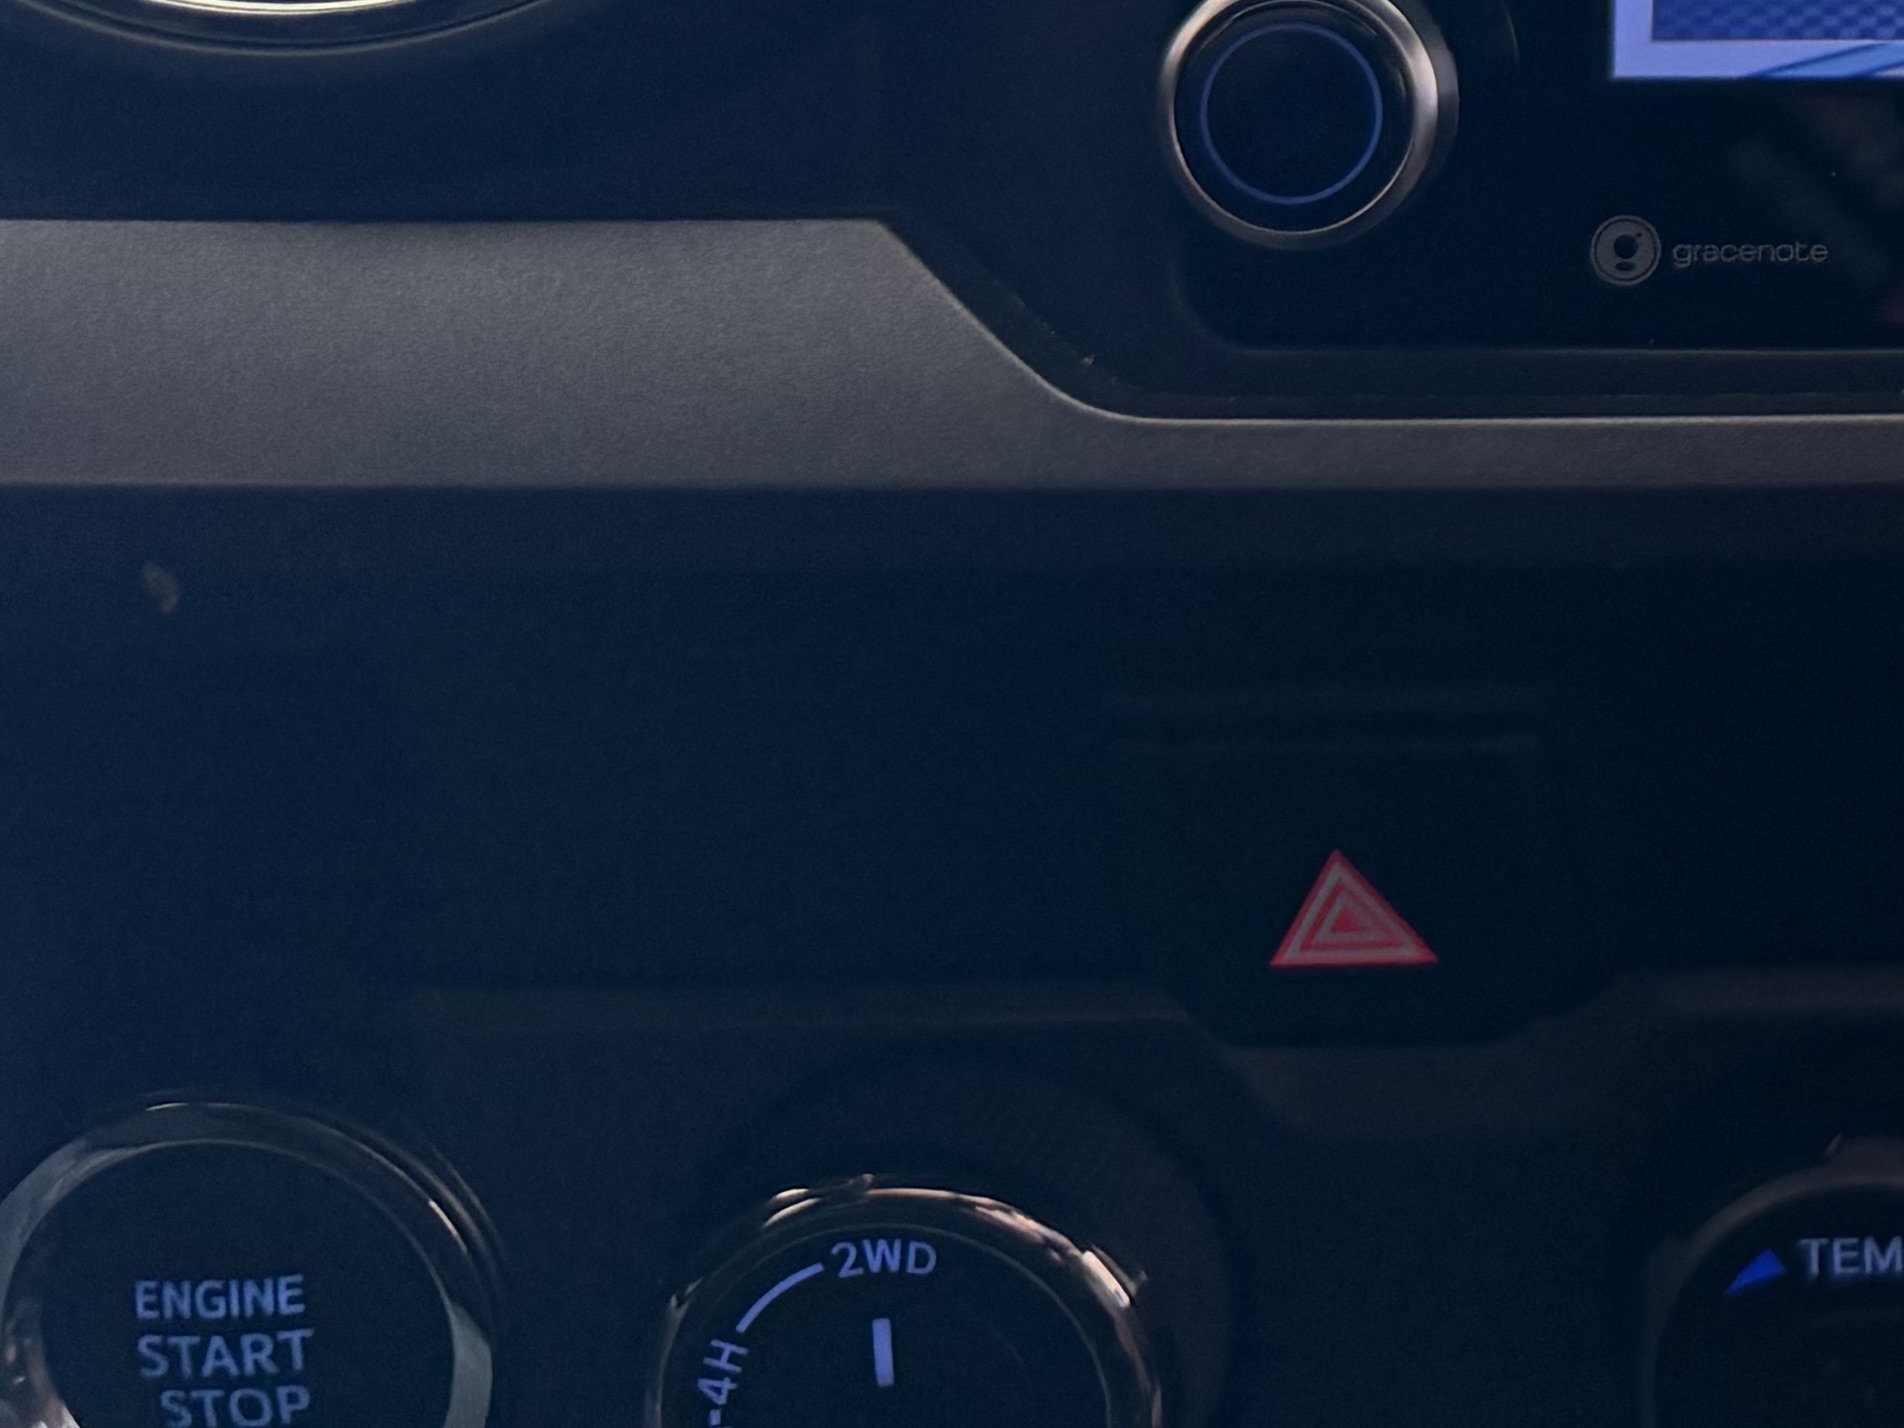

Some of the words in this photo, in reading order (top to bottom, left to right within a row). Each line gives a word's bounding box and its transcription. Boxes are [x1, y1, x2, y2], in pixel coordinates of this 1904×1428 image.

[1671, 237, 1829, 267] gracenote
[831, 1238, 937, 1279] 2WD
[136, 1275, 306, 1320] ENGINE
[139, 1329, 313, 1379] START
[159, 1387, 311, 1428] STOP
